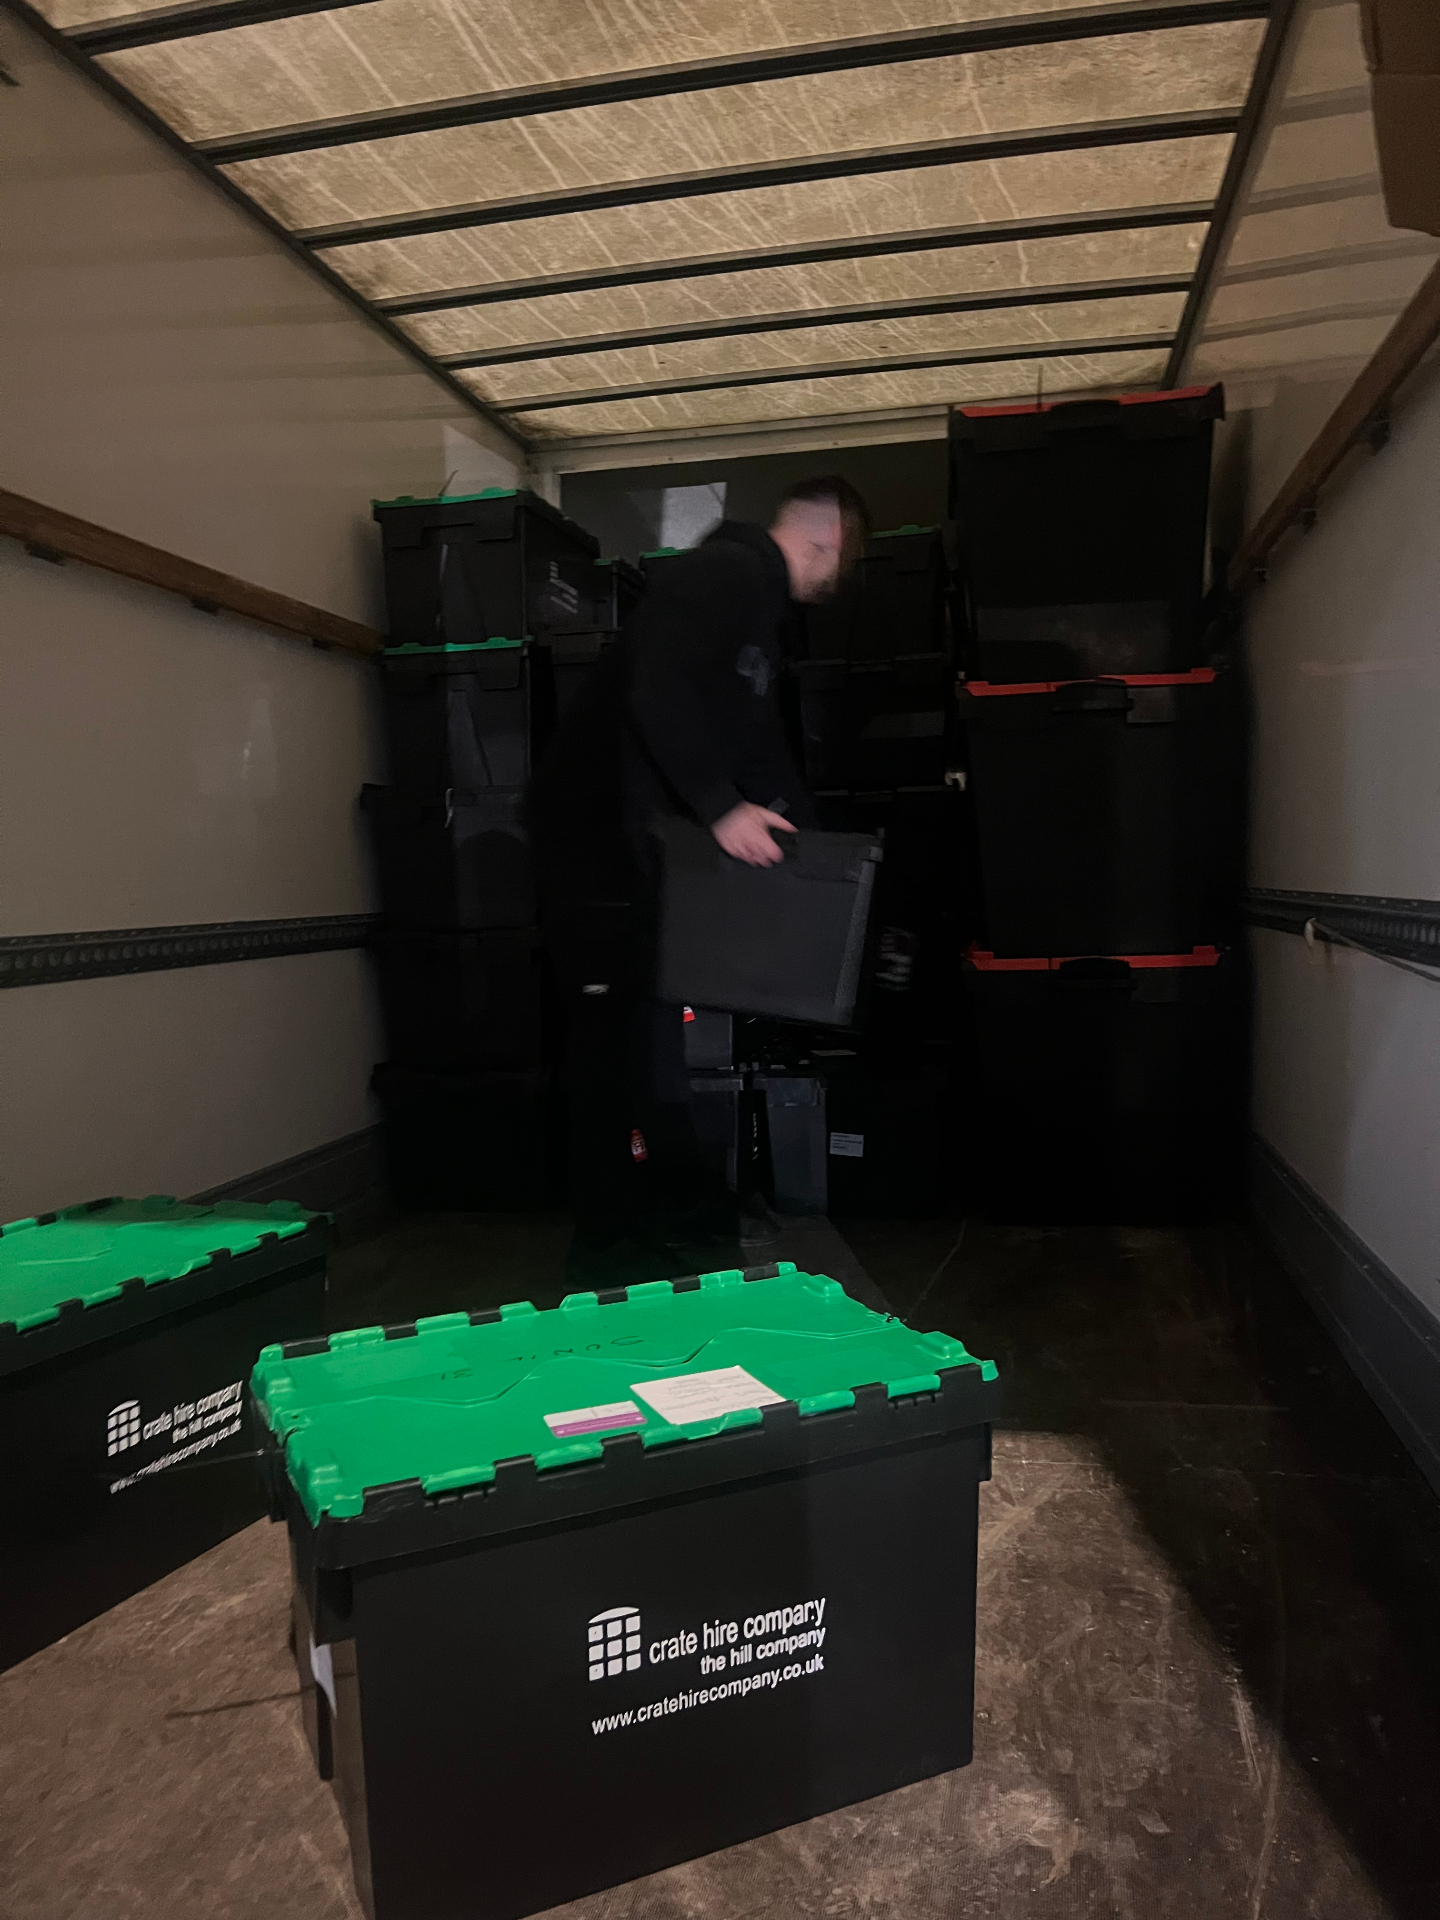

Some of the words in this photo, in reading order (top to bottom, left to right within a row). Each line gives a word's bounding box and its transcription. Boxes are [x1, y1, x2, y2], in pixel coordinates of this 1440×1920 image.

[173, 1402, 195, 1426] hire
[648, 1629, 698, 1664] crate
[703, 1619, 738, 1650] hire
[743, 1597, 826, 1639] company
[700, 1653, 726, 1675] the
[730, 1644, 753, 1667] hill
[756, 1626, 826, 1660] company
[591, 1653, 825, 1735] www.cratehirecompany.co.uk
